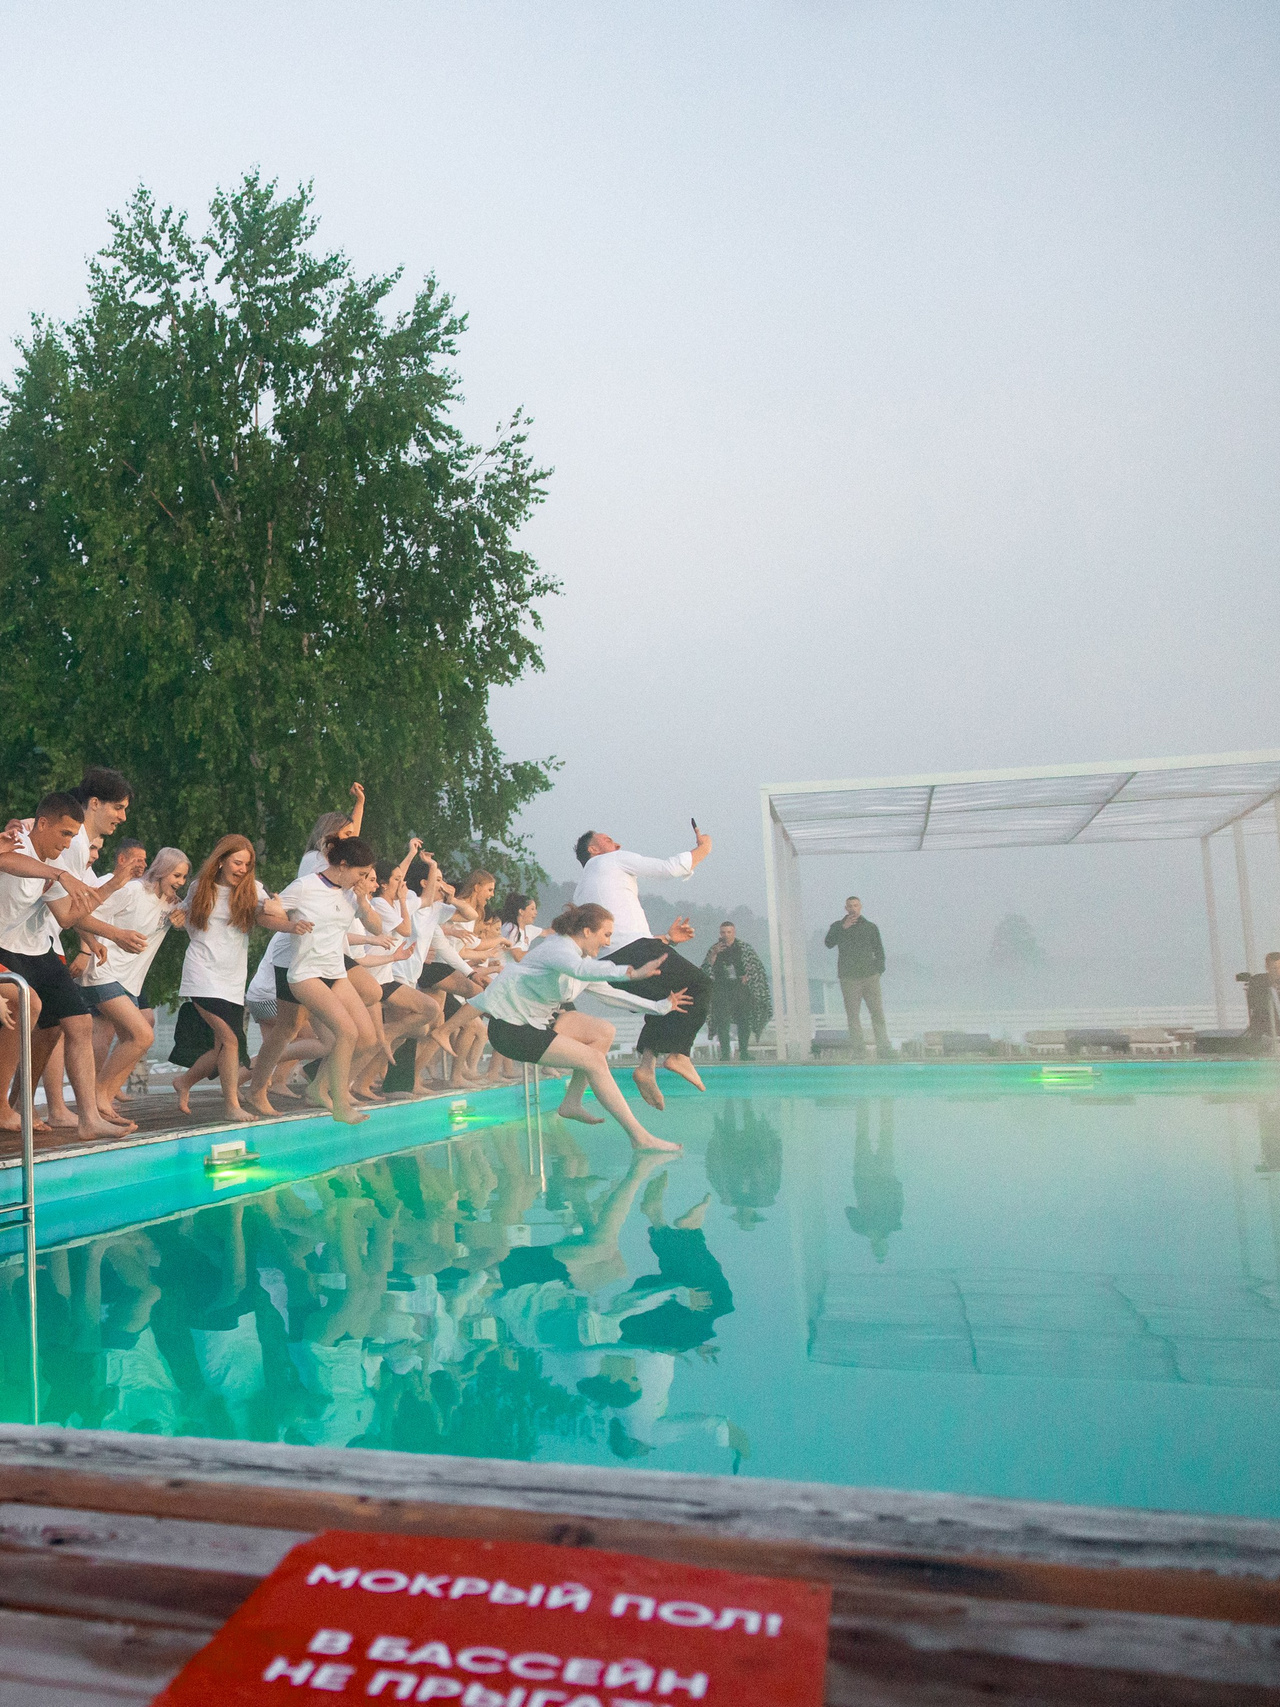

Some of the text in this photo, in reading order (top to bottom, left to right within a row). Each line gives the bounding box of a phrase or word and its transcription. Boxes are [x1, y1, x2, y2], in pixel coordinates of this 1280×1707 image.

[306, 1563, 783, 1638] МОКРЫЙ ПОЛ!
[262, 1655, 357, 1692] НЕ
[307, 1628, 709, 1700] В БАССЕЙН
